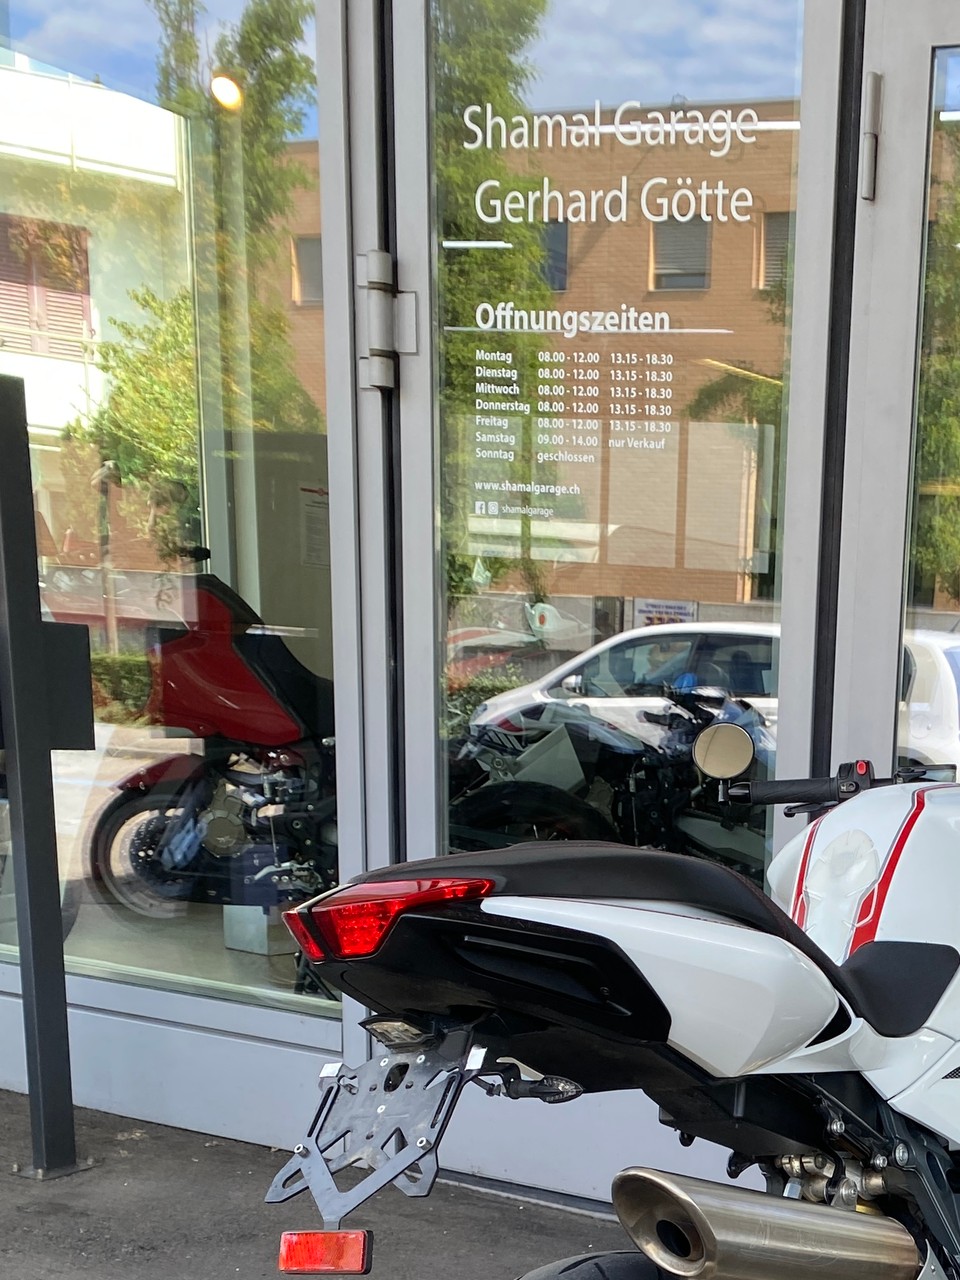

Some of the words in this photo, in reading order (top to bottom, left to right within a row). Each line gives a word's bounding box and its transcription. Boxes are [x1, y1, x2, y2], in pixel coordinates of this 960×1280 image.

[463, 99, 600, 150] Shamal
[613, 100, 759, 158] Garage
[475, 175, 628, 223] Gerhard
[640, 177, 754, 223] Götte
[476, 350, 512, 364] Montag
[538, 352, 564, 362] 08.00
[573, 352, 599, 363] 12.00
[611, 353, 637, 364] 13.15
[646, 354, 673, 365] 18.30
[476, 366, 517, 380] Dienstag
[538, 368, 564, 379] 08.00
[573, 369, 599, 380] 12.00
[610, 370, 637, 381] 13.15
[646, 371, 672, 381] 18.30
[476, 383, 519, 395] Mittwoch
[538, 385, 564, 396] 08.00
[572, 386, 599, 397] 12.00
[610, 387, 636, 398] 13.15
[645, 388, 672, 398] 18.30
[476, 400, 530, 414] Donnerstag
[538, 402, 564, 412] 08.00
[572, 403, 598, 413] 12.00
[610, 404, 636, 415] 13.15
[645, 404, 672, 415] 18.30
[476, 416, 508, 429] Freitag
[538, 418, 564, 429] 08.00
[572, 419, 598, 430] 12.00
[609, 420, 636, 431] 13.15
[645, 421, 671, 432] 18.30
[476, 432, 515, 445] Samstag
[538, 435, 563, 446] 09.00
[572, 436, 598, 447] 14.00
[609, 439, 624, 448] nur
[627, 438, 665, 449] Verkauf
[476, 448, 514, 461] Sonntag
[538, 451, 594, 463] geschlossen
[475, 481, 580, 495] www.shamalgarage.ch
[502, 505, 553, 516] shamalgarage
